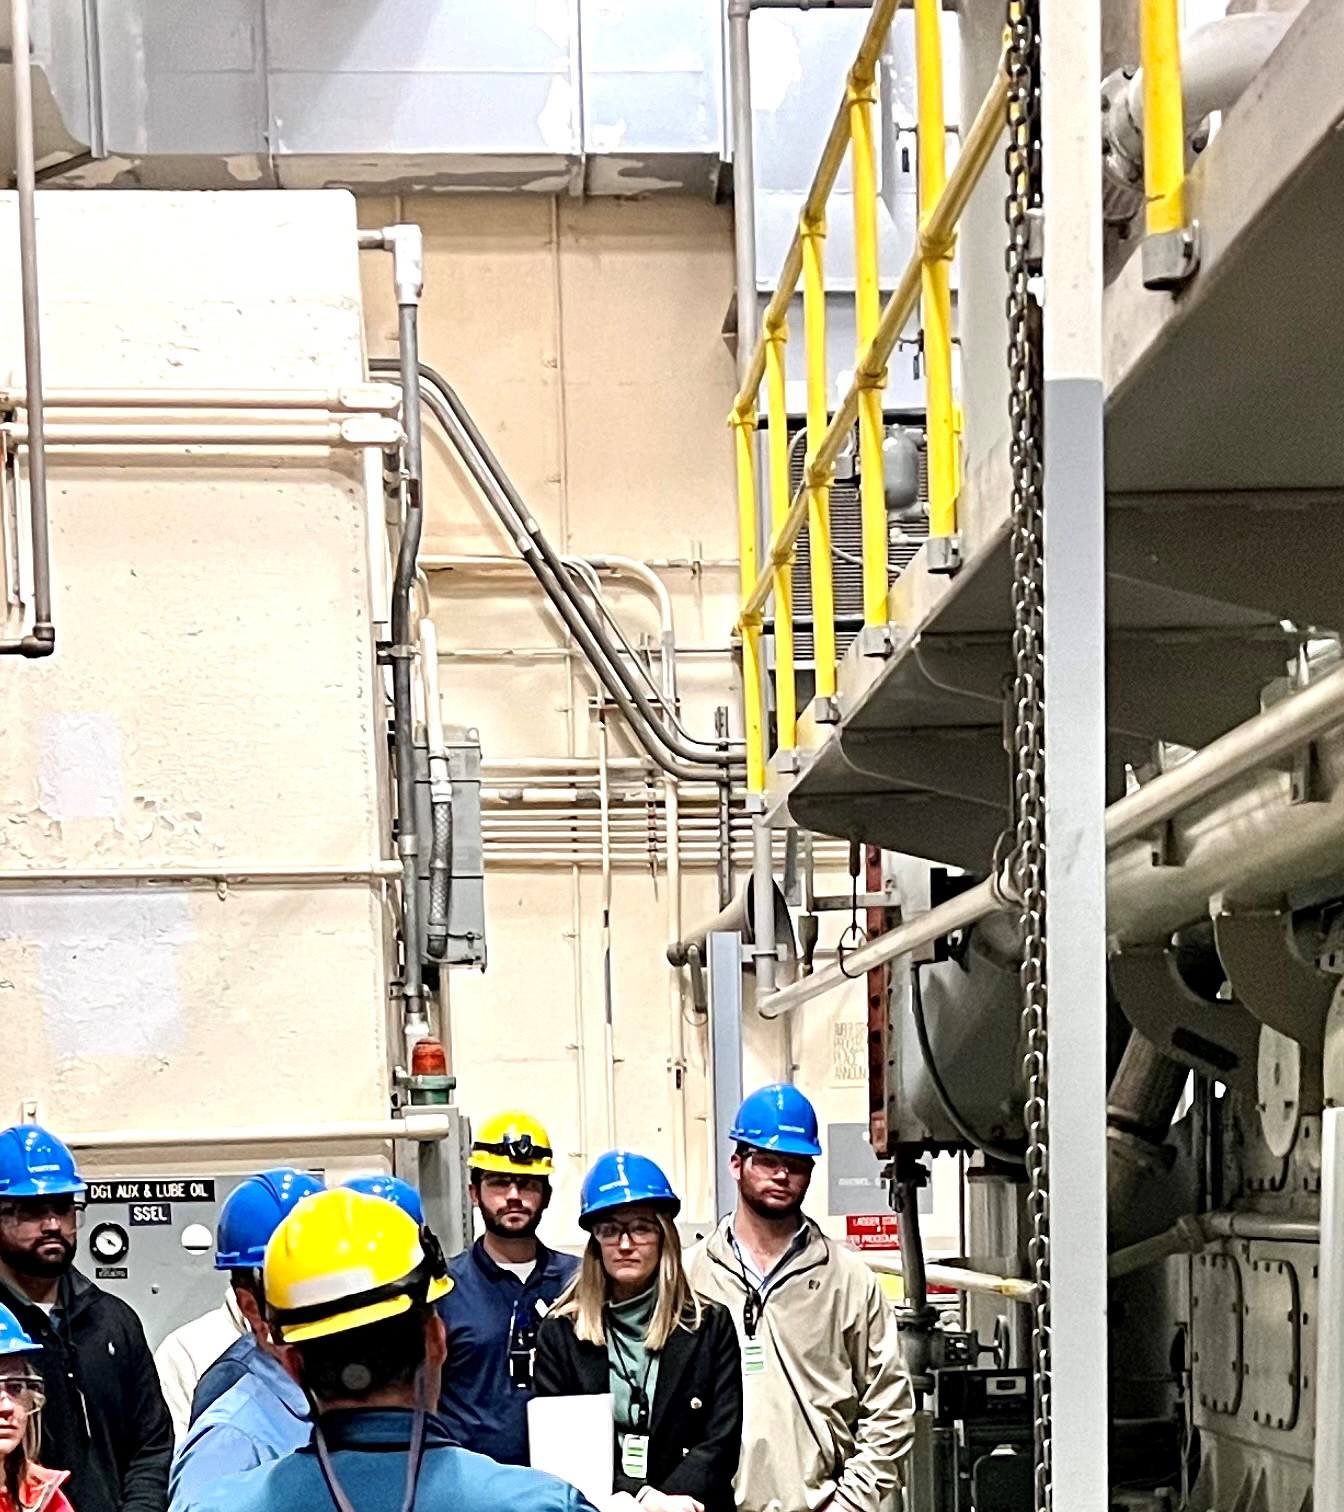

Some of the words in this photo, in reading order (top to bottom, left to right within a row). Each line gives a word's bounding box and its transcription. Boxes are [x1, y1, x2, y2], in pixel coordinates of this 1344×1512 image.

[90, 1184, 112, 1199] DG1
[116, 1184, 140, 1199] AUX
[143, 1183, 153, 1198] &
[156, 1183, 186, 1198] LUBE
[189, 1182, 209, 1198] OIL
[133, 1206, 168, 1222] SSEL
